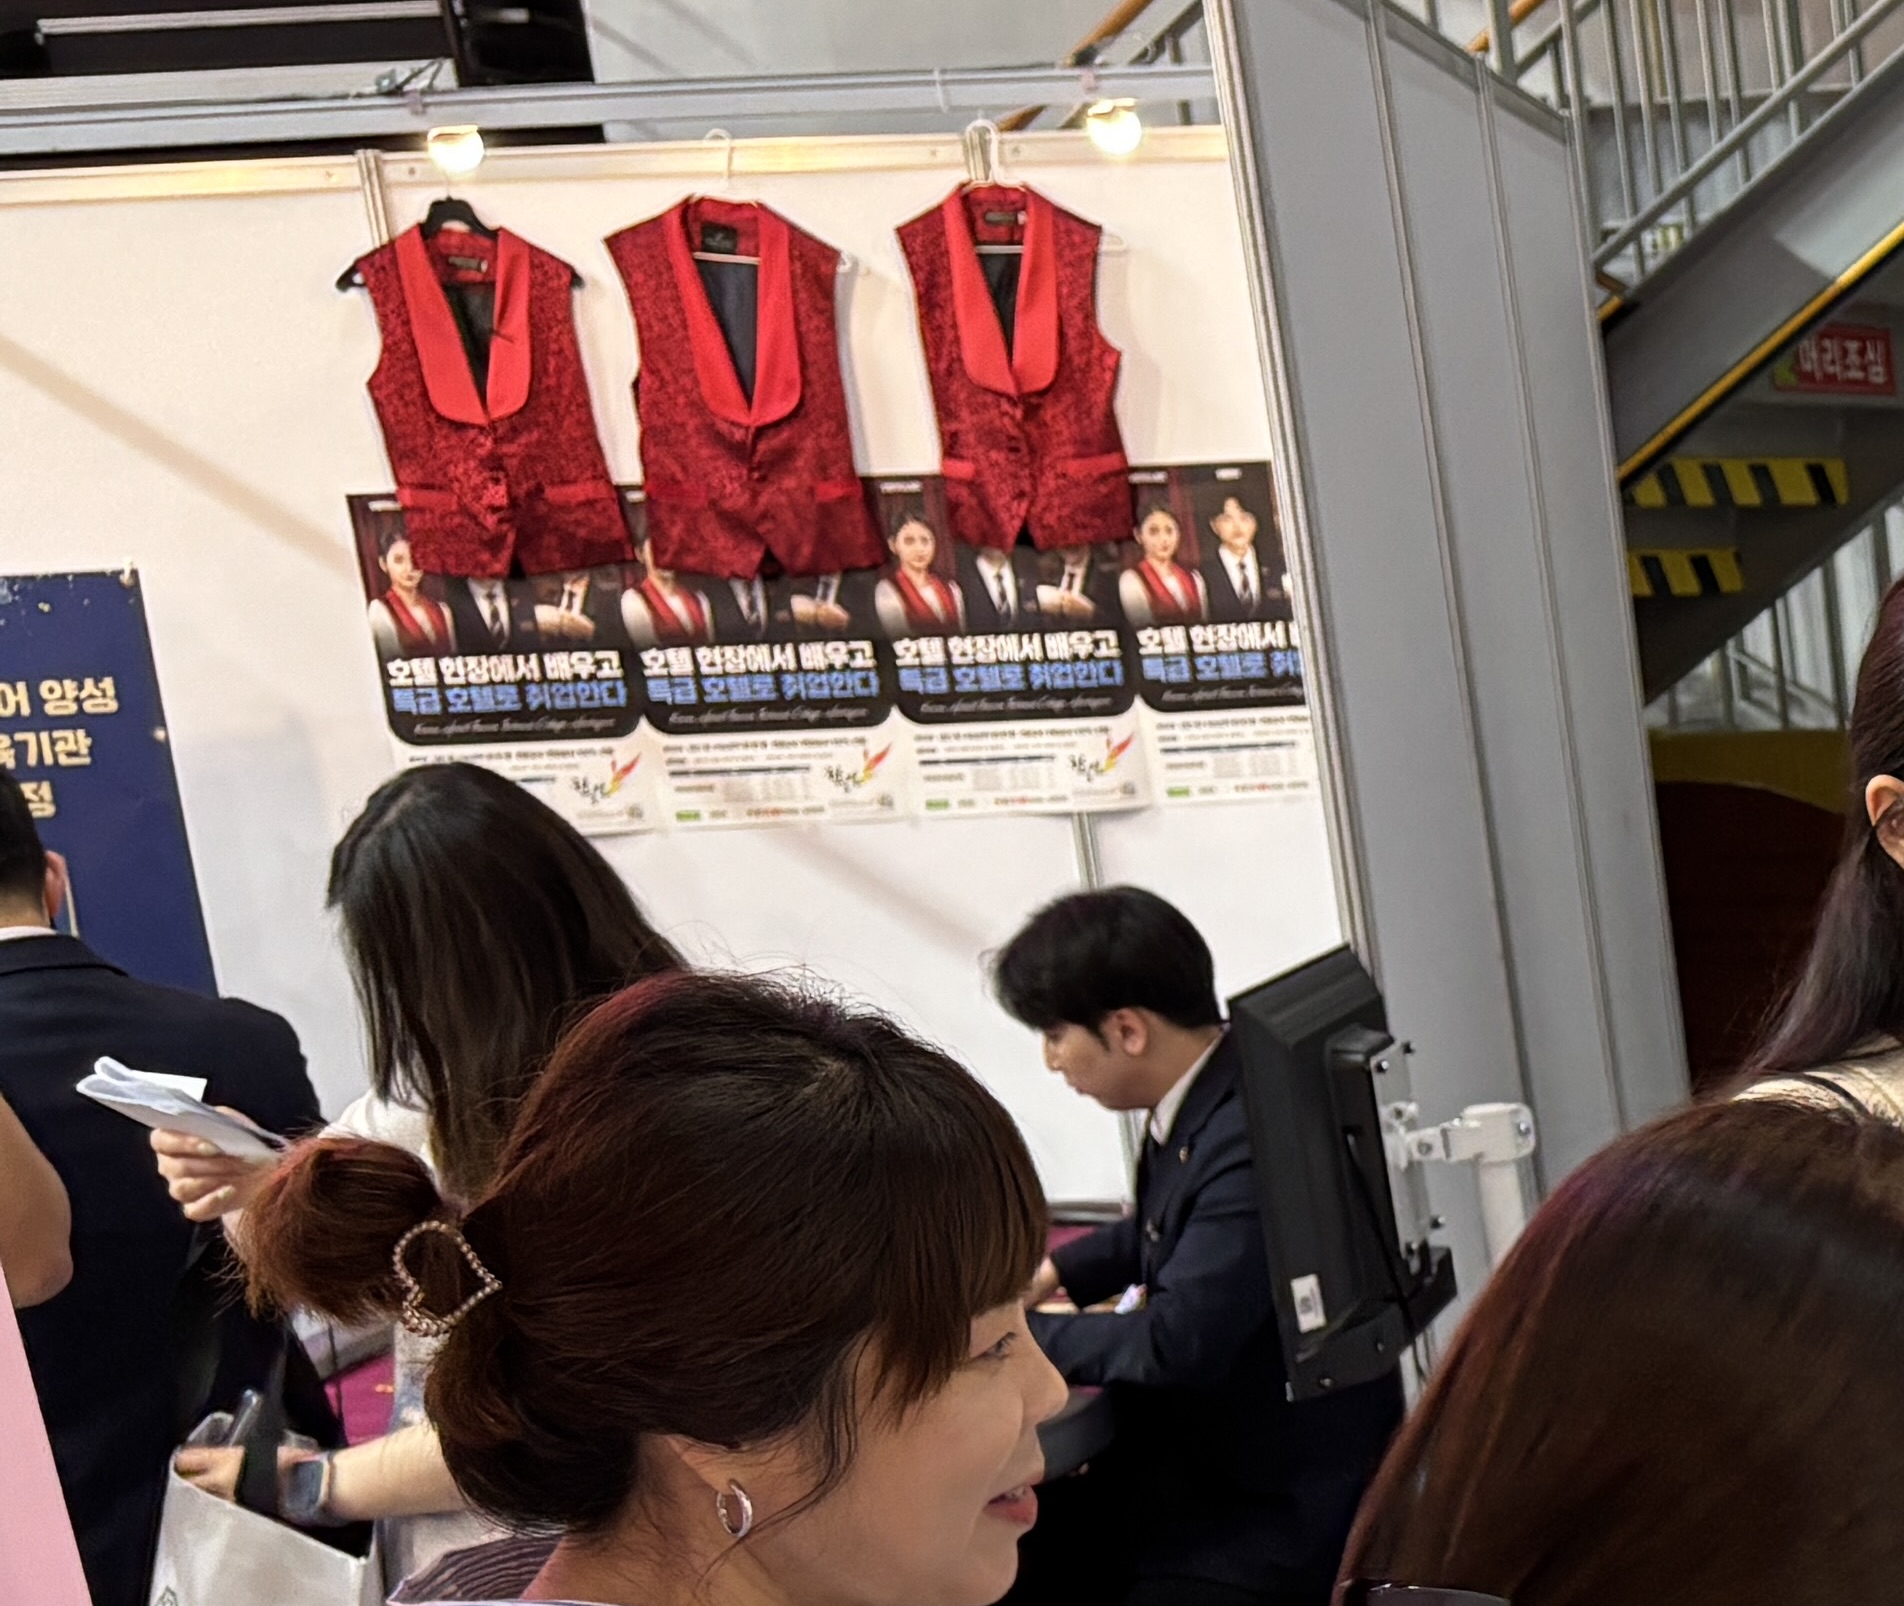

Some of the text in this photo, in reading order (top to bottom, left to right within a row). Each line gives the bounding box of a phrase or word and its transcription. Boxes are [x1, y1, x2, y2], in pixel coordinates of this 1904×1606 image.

[894, 630, 1121, 666] 호텔 현장에서 배우고
[1138, 627, 1185, 654] 호텔
[1190, 623, 1284, 652] 현장에서
[387, 650, 624, 687] 호텔 현장에서 배우고
[640, 640, 875, 677] 호텔 현장에서 배우고
[1195, 653, 1266, 680] 호텔로
[702, 673, 777, 702] 호텔로
[953, 664, 1024, 692] 호텔로
[39, 677, 119, 715] 양성
[446, 684, 521, 713] 호텔로
